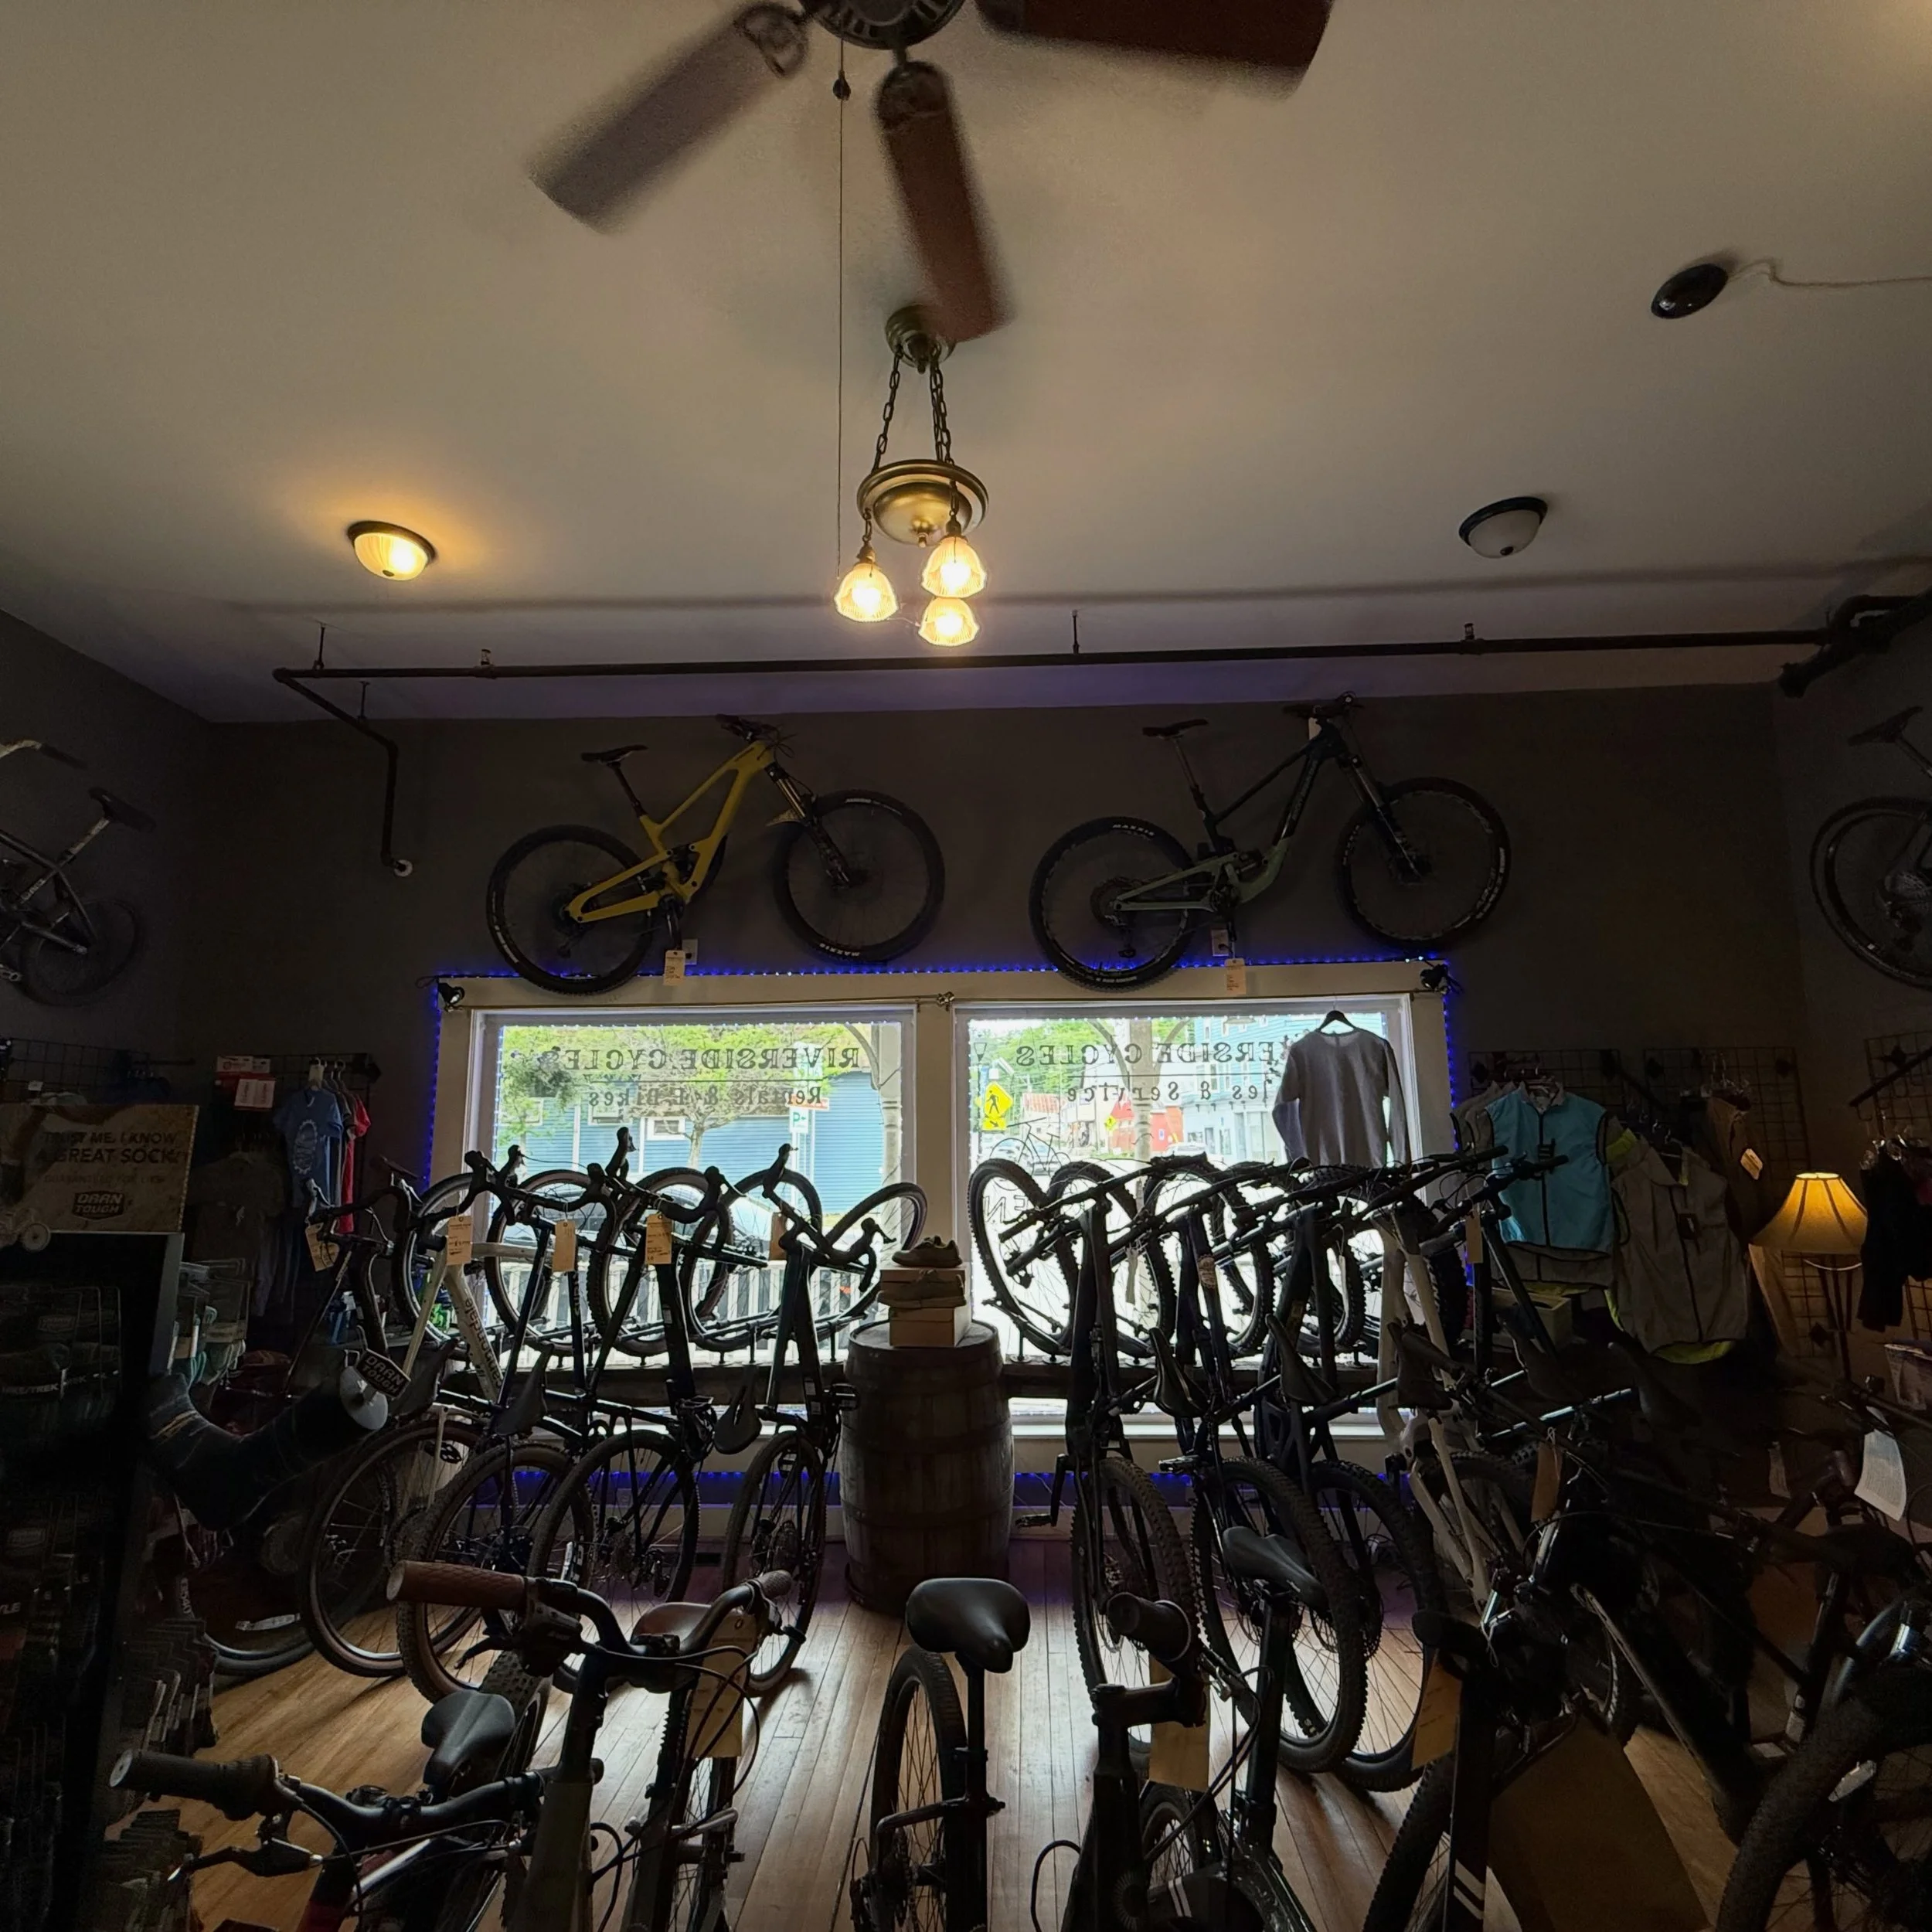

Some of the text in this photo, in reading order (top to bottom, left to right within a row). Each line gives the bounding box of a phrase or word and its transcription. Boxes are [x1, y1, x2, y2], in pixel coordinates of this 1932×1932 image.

[55, 1148, 115, 1163] GREAT
[74, 1204, 121, 1215] TOUGH
[76, 1193, 123, 1204] DARN
[465, 1298, 502, 1388] cannondale
[362, 1364, 400, 1393] TOUGH
[365, 1355, 404, 1385] DARN
